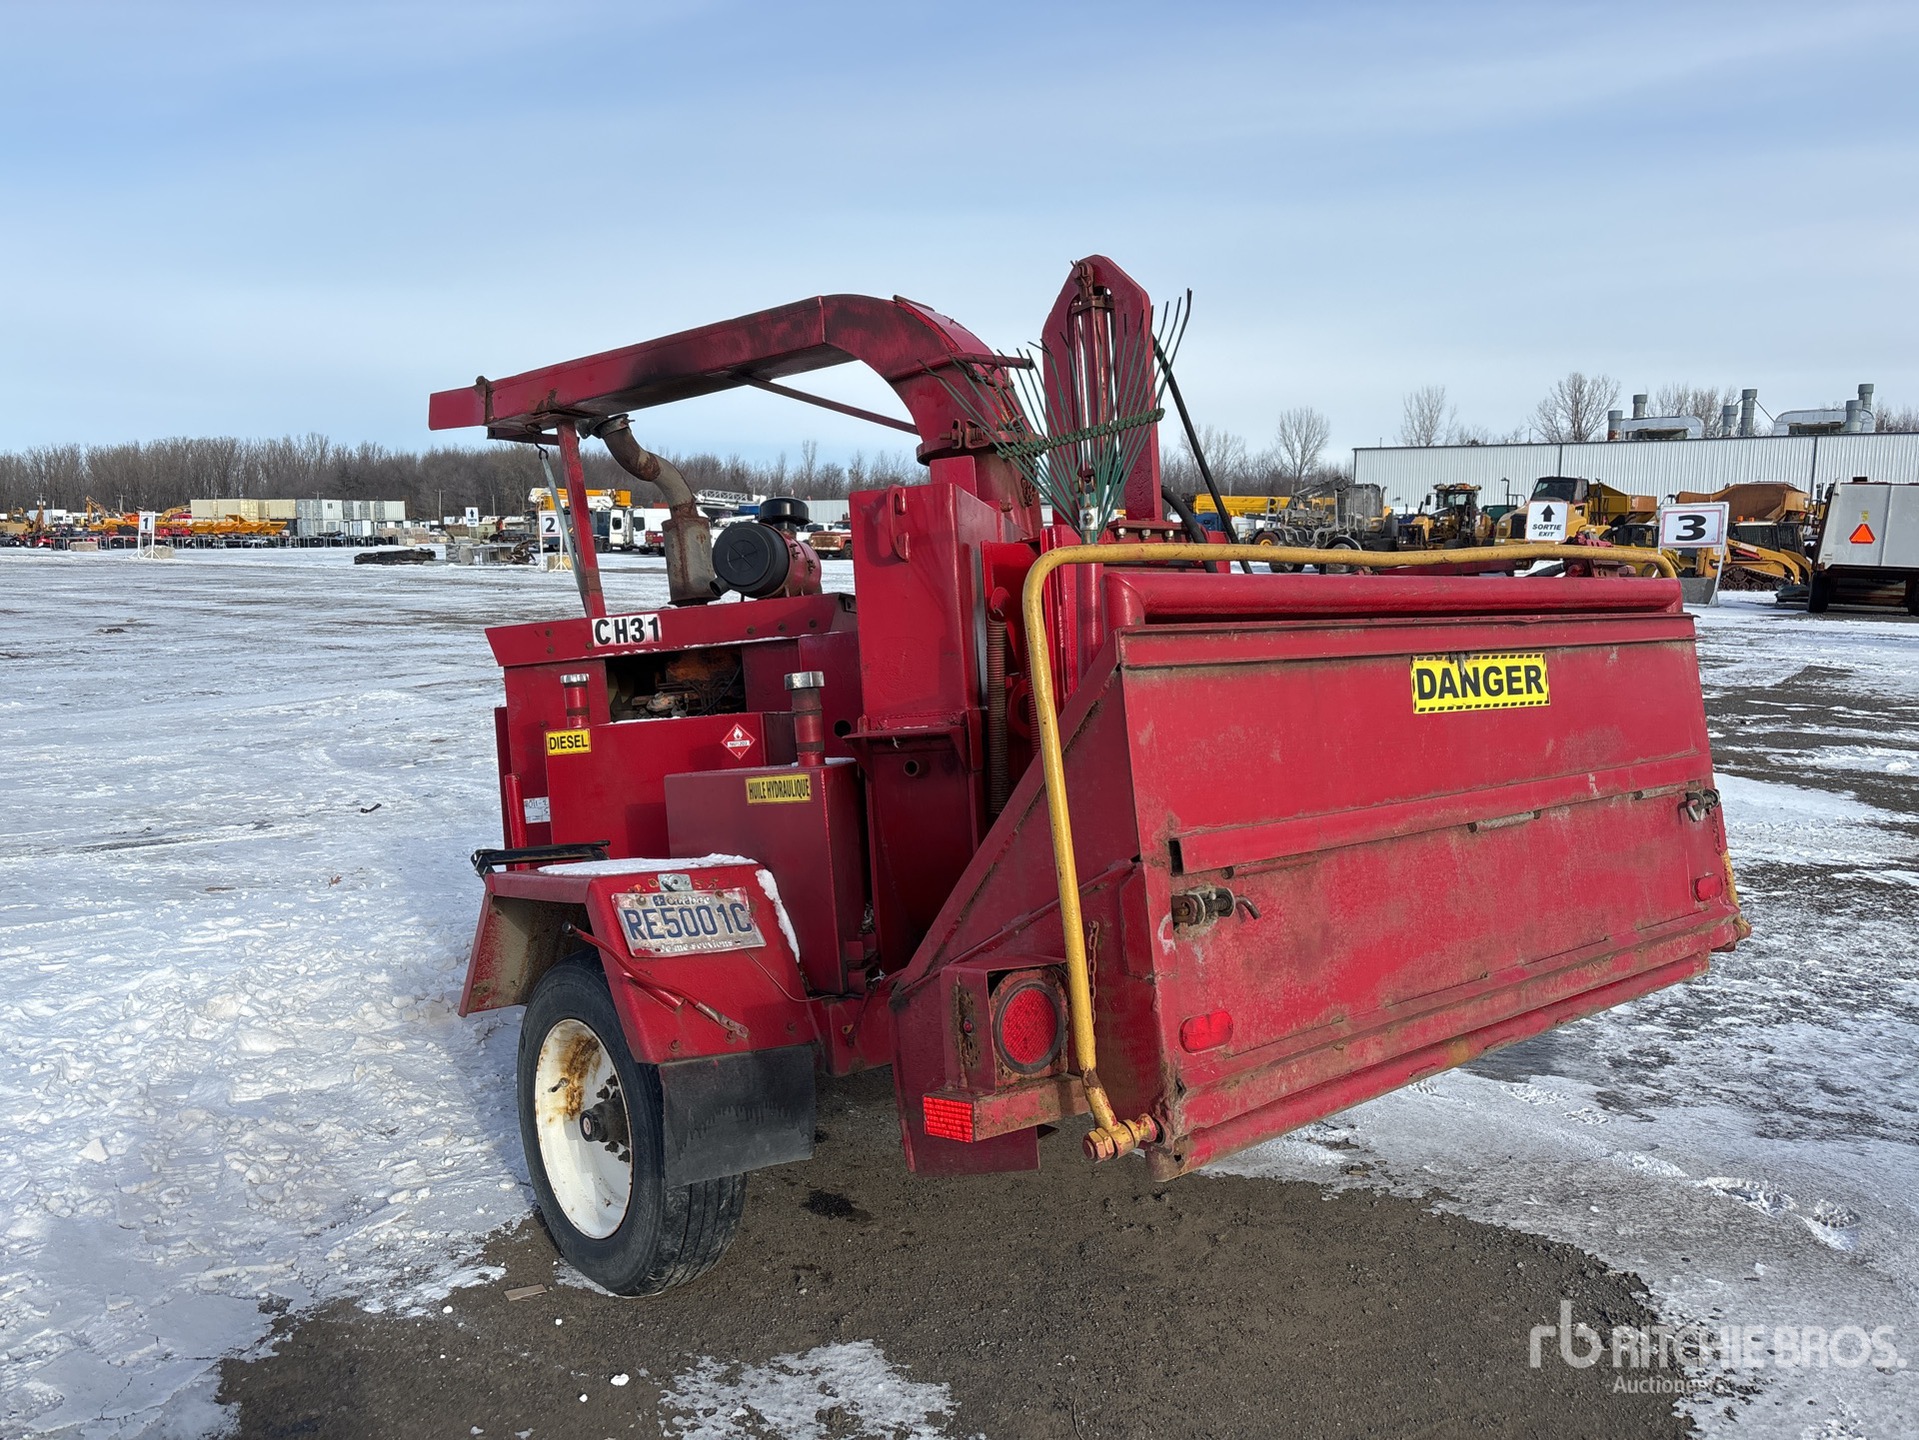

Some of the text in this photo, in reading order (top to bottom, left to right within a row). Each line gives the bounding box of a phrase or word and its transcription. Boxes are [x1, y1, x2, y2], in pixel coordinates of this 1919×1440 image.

[143, 517, 149, 530] 1
[545, 517, 556, 533] 2
[1532, 523, 1562, 531] SORTIE
[1676, 514, 1707, 542] 3
[595, 617, 659, 645] CH31
[1416, 665, 1544, 700] DANGER
[549, 735, 588, 750] DIESEL
[748, 779, 810, 800] HUILE HYDRAULIQUE
[624, 902, 753, 940] RE5001C
